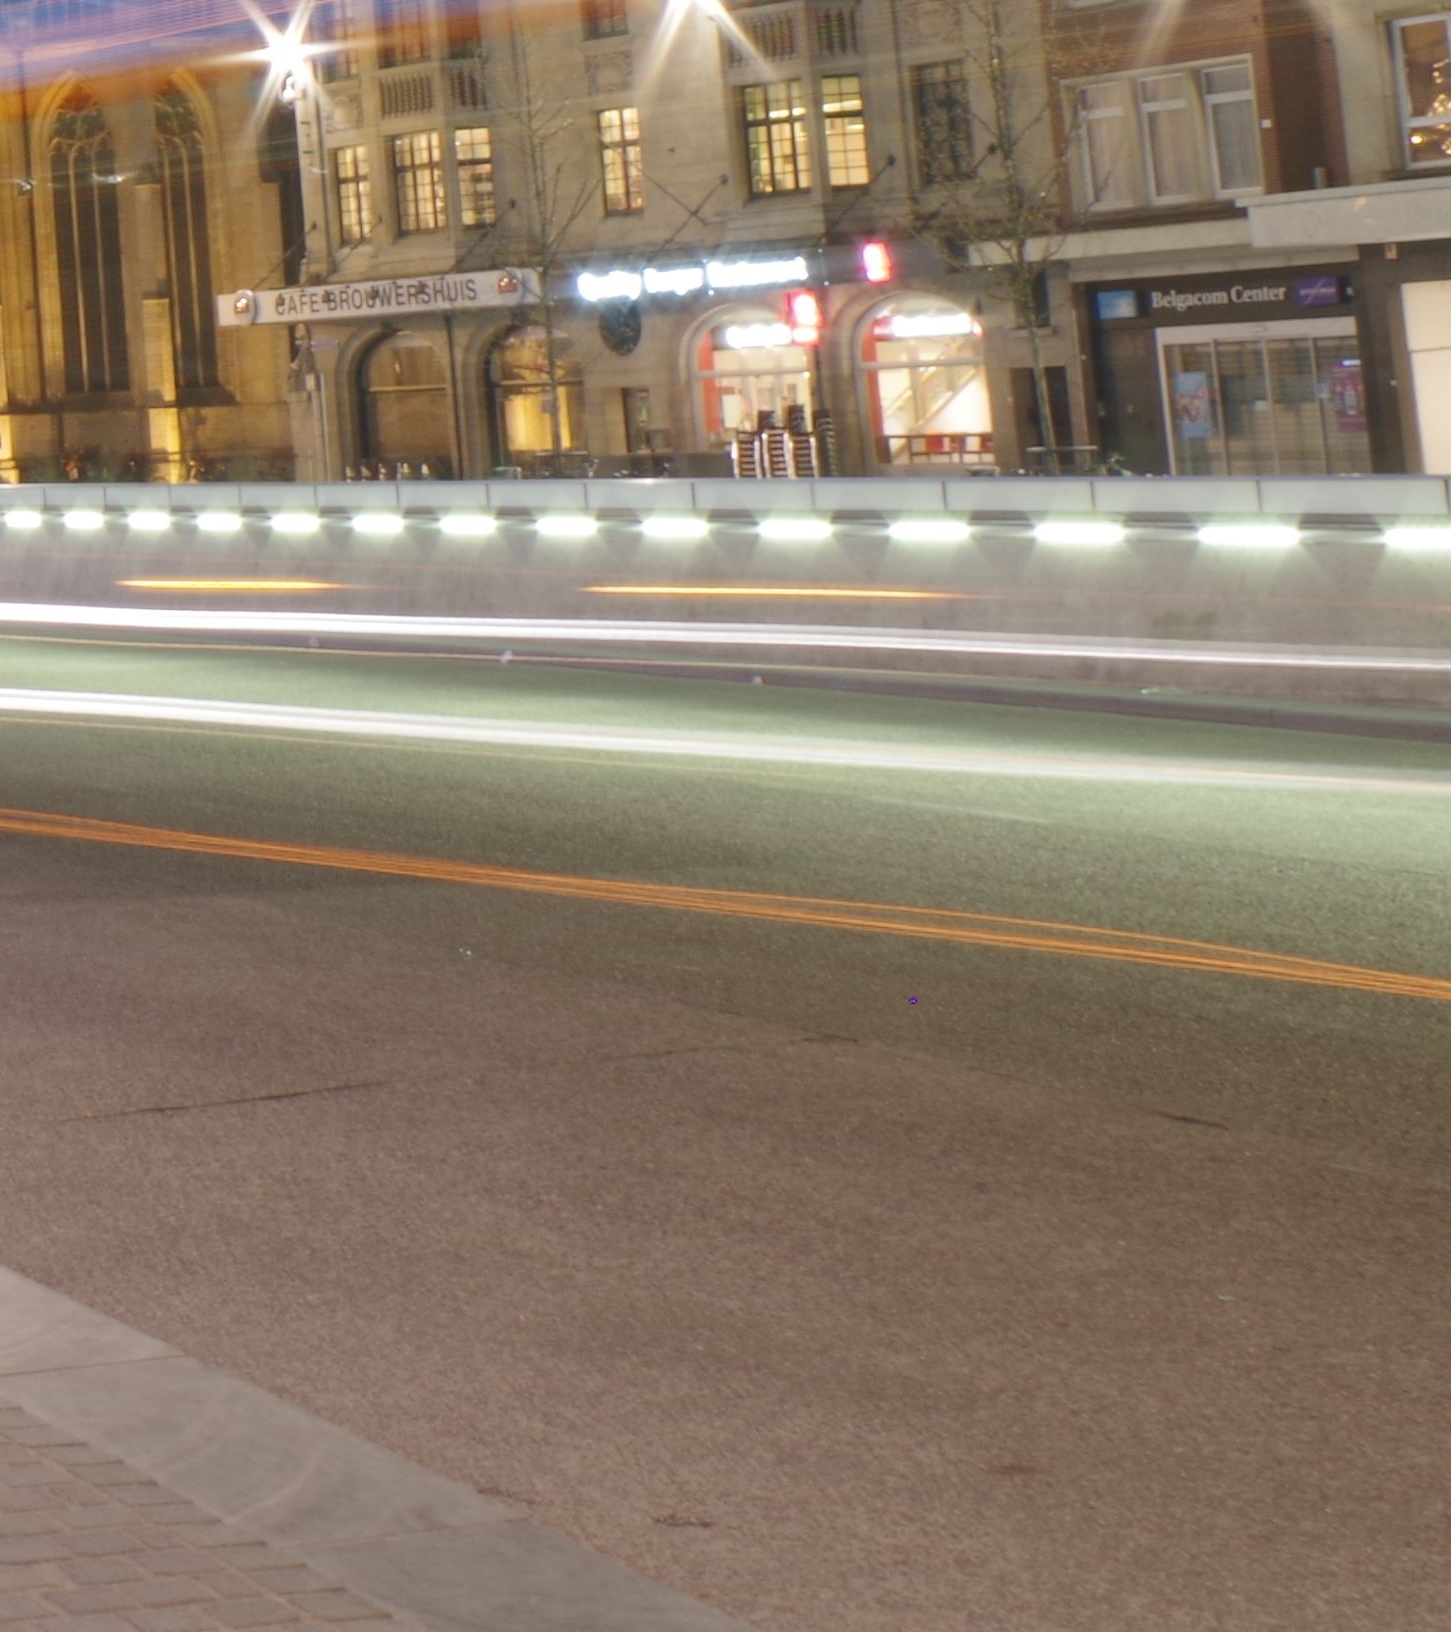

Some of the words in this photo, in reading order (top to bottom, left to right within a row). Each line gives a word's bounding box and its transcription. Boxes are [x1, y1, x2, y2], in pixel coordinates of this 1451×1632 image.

[327, 278, 478, 313] BROUWERSHUIS
[1151, 288, 1229, 312] Belgacom
[1230, 284, 1287, 304] Center
